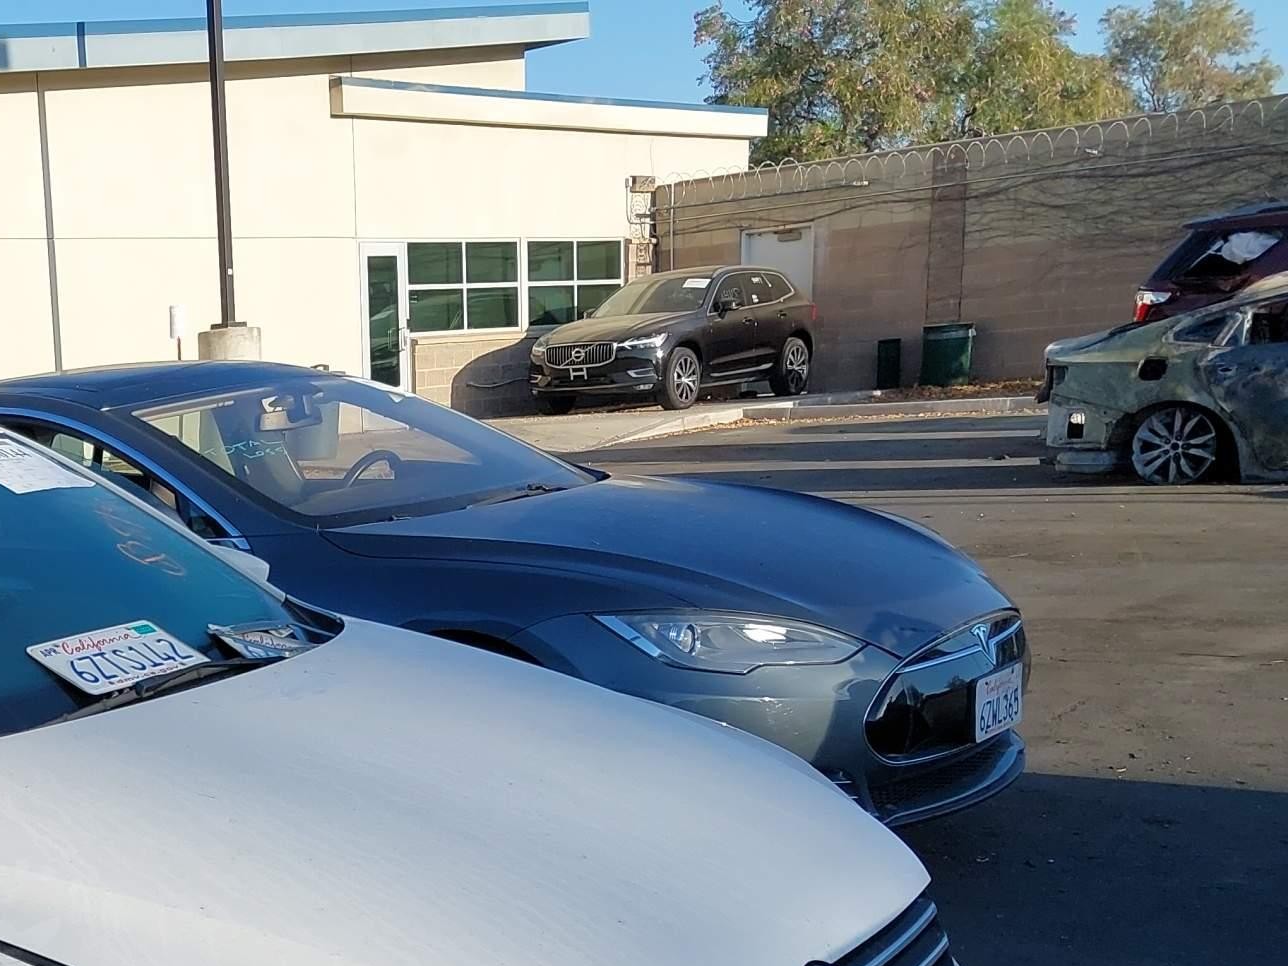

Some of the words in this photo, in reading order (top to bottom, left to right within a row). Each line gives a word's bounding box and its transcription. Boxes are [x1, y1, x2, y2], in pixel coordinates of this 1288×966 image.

[39, 645, 59, 658] APR
[62, 630, 141, 656] California
[70, 638, 194, 683] 6ZTS142
[979, 685, 1019, 732] 6ZWL365
